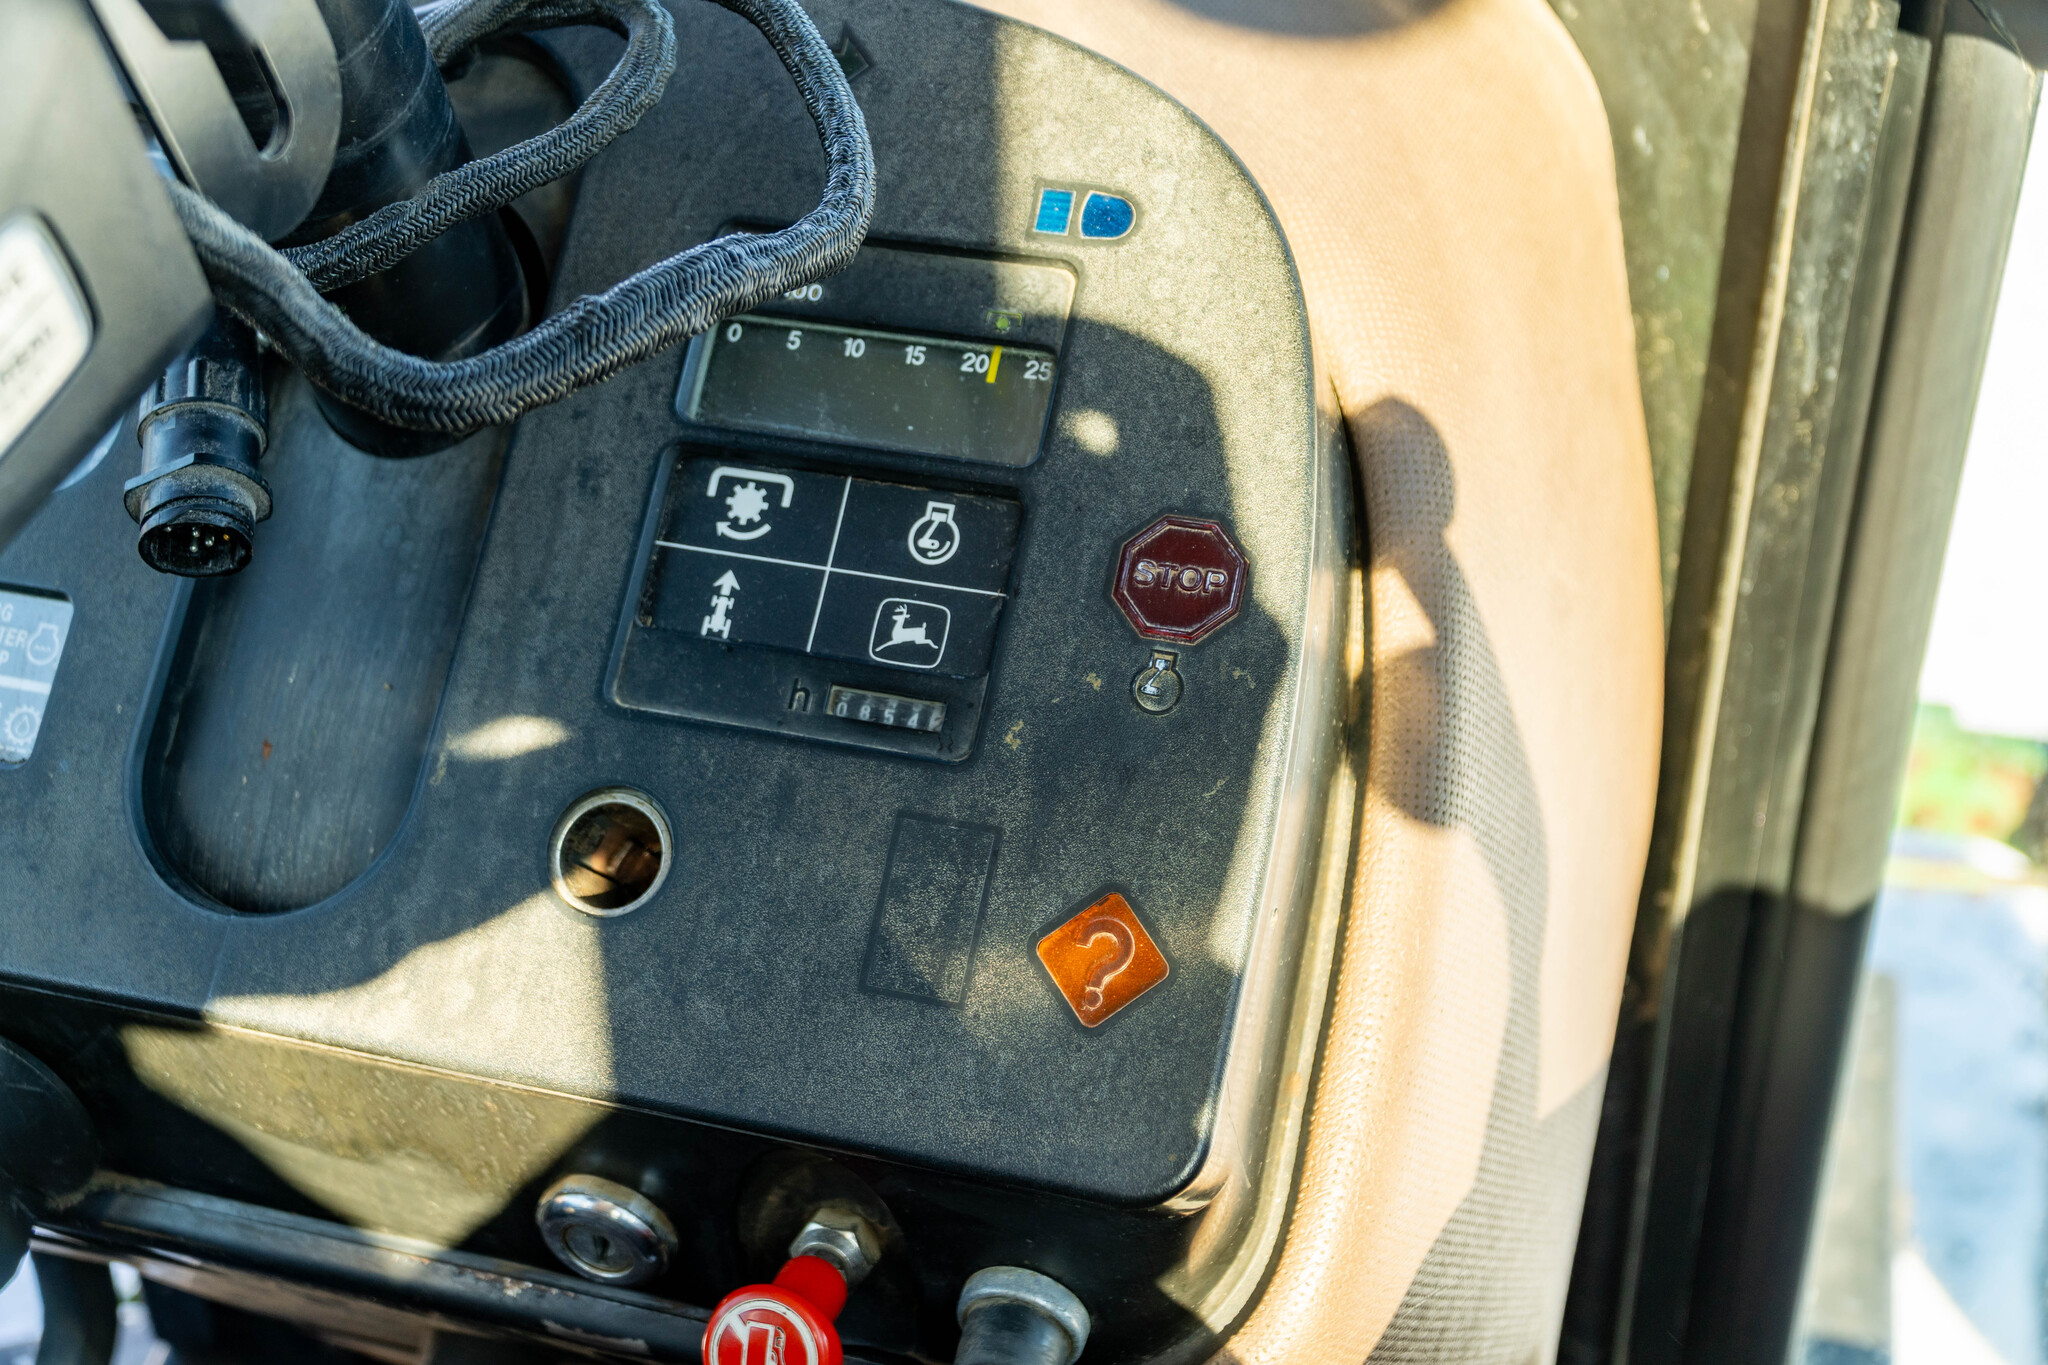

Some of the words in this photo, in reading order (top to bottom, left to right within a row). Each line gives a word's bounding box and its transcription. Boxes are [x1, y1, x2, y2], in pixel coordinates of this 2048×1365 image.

[784, 284, 823, 302] 00
[727, 323, 743, 343] 0
[786, 330, 802, 350] 5
[844, 337, 866, 358] 10
[905, 345, 927, 366] 15
[960, 352, 990, 374] 20
[1023, 360, 1053, 381] 25
[1133, 559, 1229, 594] STOP
[788, 678, 812, 713] h
